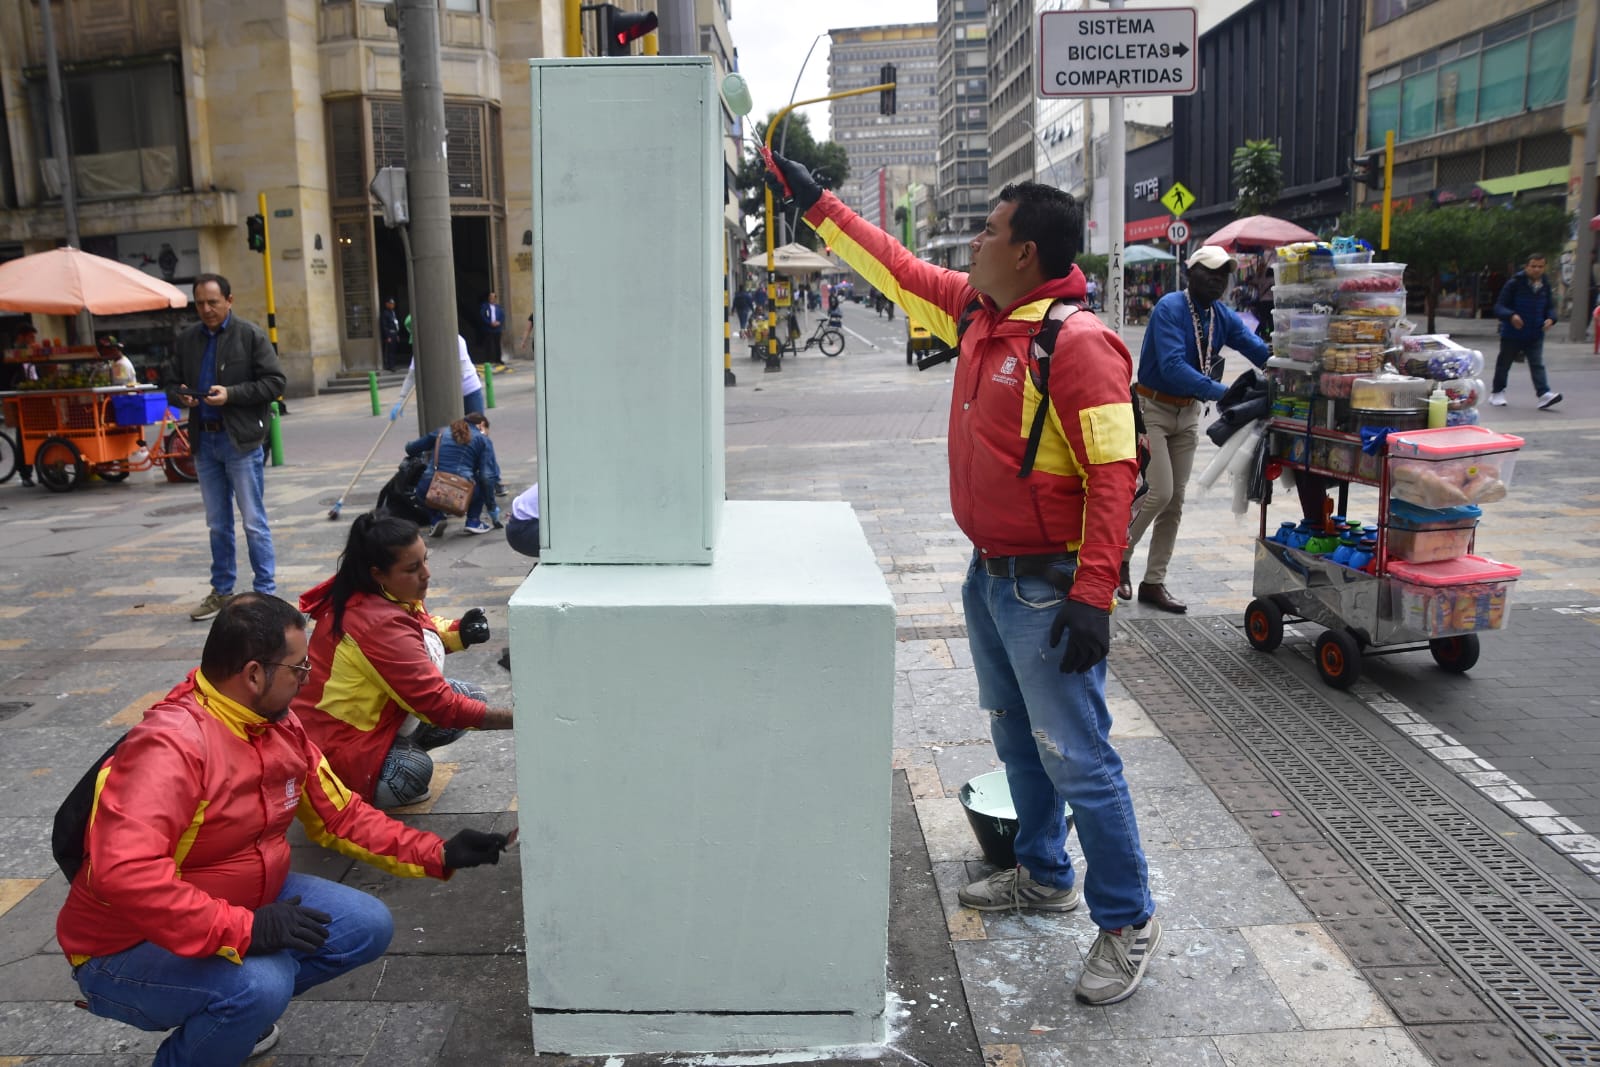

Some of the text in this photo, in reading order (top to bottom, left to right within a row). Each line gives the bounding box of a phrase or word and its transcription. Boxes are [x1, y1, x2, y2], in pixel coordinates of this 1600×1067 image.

[1078, 19, 1155, 35] SISTEMA
[1068, 43, 1170, 61] BICICLETAS
[1055, 68, 1183, 86] COMPARTIDAS
[1171, 226, 1186, 239] 10
